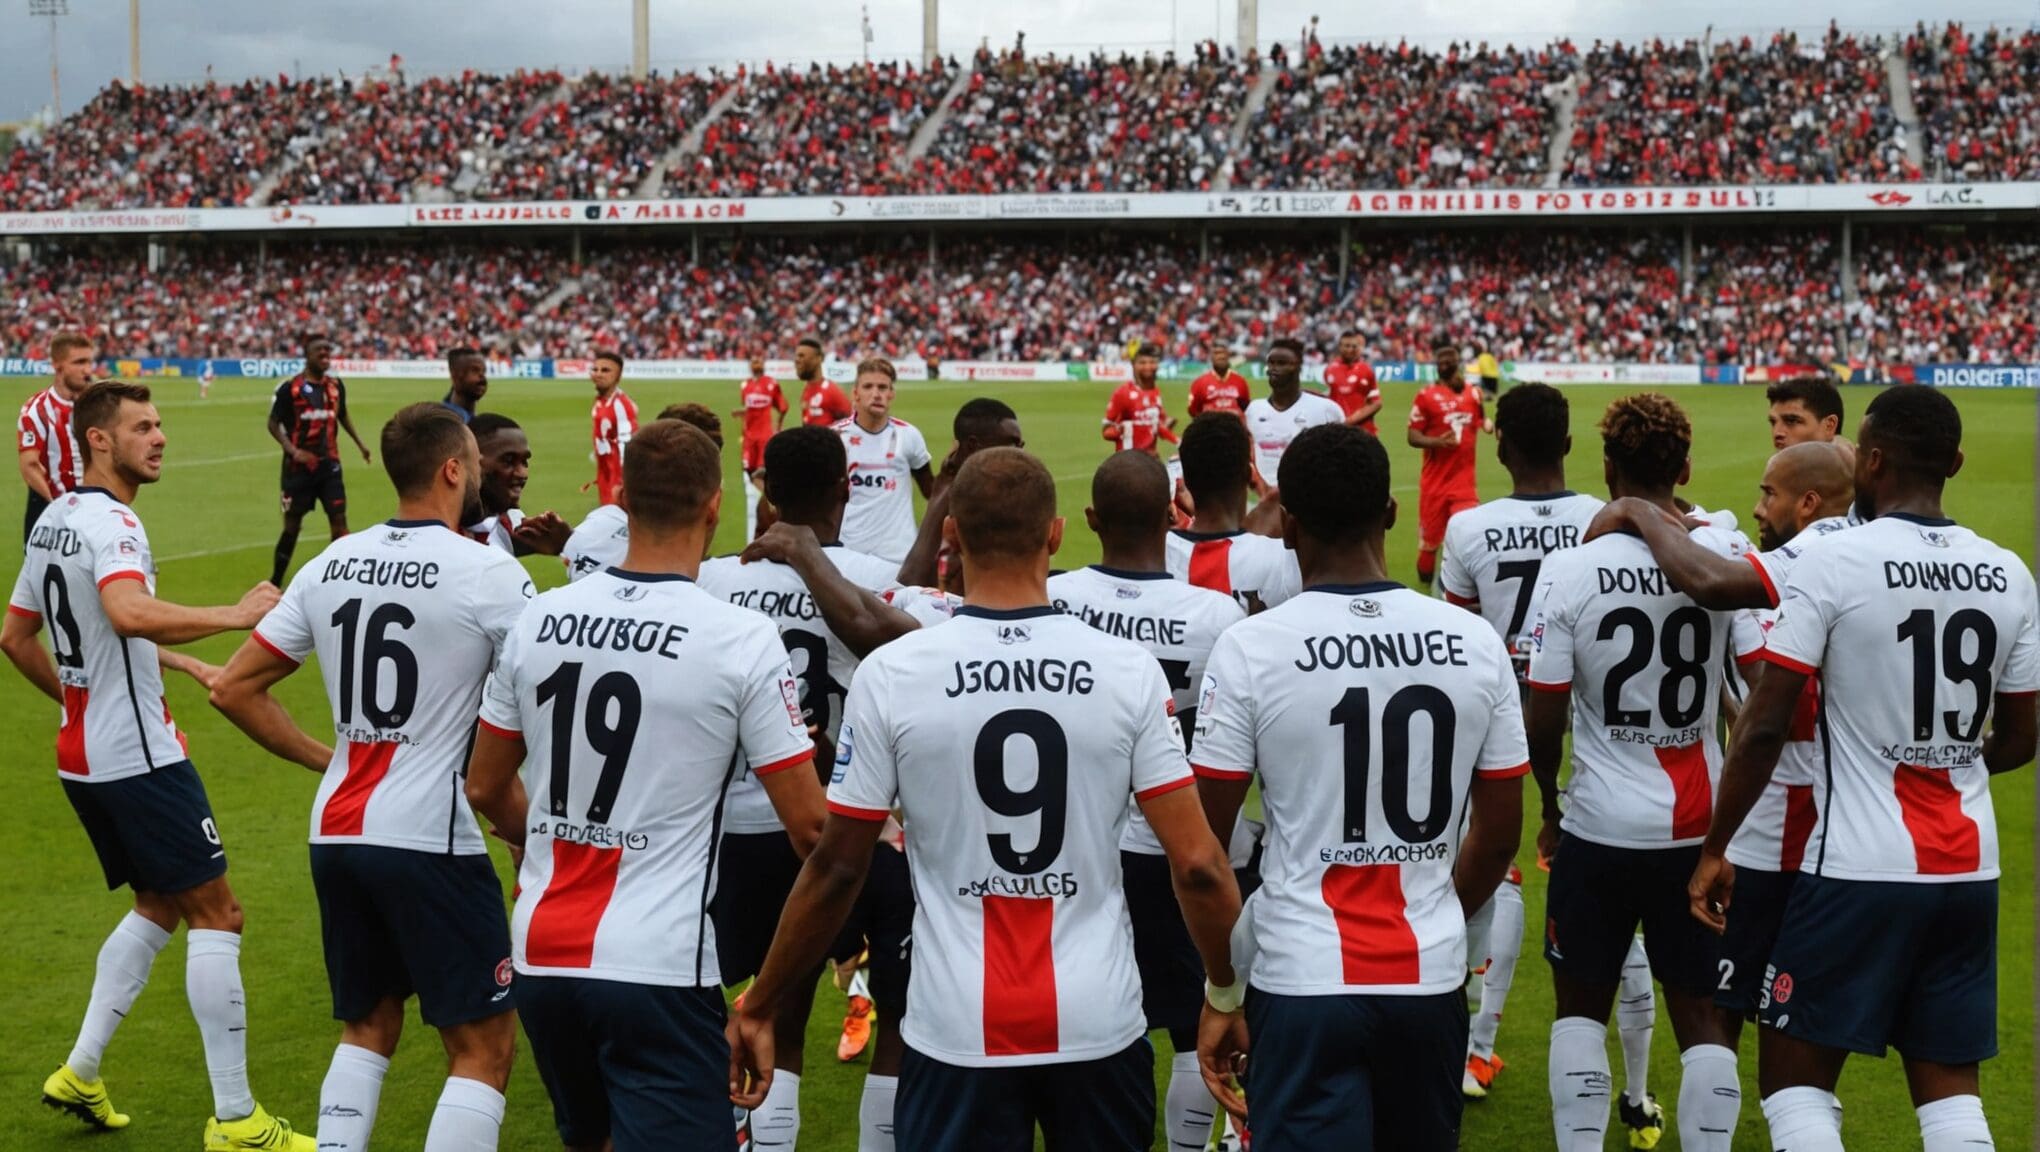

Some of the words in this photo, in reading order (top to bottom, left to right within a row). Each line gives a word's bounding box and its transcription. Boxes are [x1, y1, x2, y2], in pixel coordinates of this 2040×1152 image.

[331, 598, 418, 730] 16
[1495, 559, 1541, 637] 7
[1596, 606, 1712, 729] 28
[535, 660, 643, 825] 19
[973, 708, 1069, 876] 9
[1329, 684, 1457, 845] 10
[1717, 958, 1735, 991] 2
